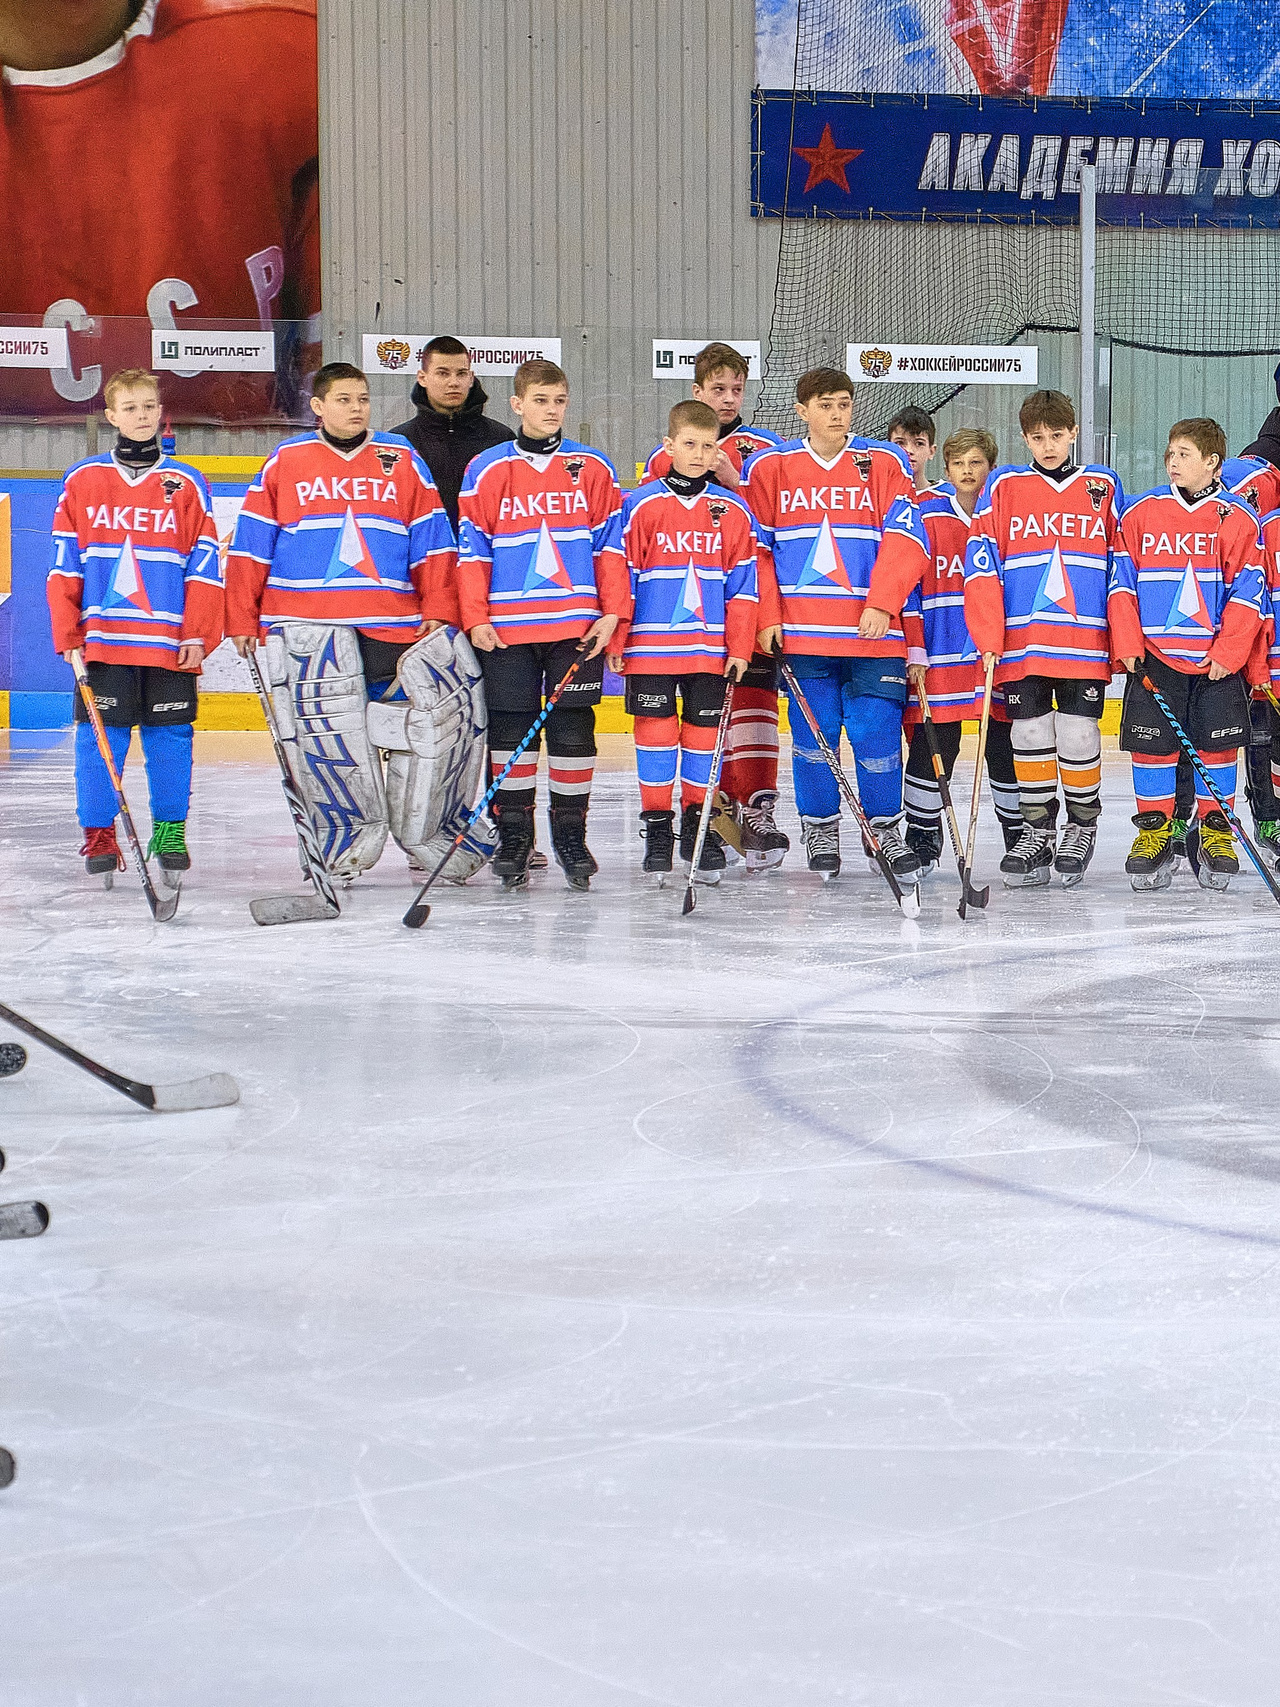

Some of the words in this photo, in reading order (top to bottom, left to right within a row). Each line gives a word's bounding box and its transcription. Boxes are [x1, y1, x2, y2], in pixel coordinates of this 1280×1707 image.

[918, 132, 1205, 200] АКАДЕМИЯ
[184, 346, 261, 357] ПОЛИПЛАСТ
[897, 355, 1022, 373] #ХОККЕЙРОССИИ75
[295, 476, 399, 507] РАКЕТА
[780, 486, 875, 514] РАКЕТА
[499, 489, 589, 521] РАКЕТА
[894, 506, 915, 530] 4
[1009, 512, 1108, 541] РАКЕТА
[1141, 532, 1219, 556] РАКЕТ
[936, 555, 966, 580] РА
[973, 544, 990, 570] 6
[152, 702, 189, 713] EFSI
